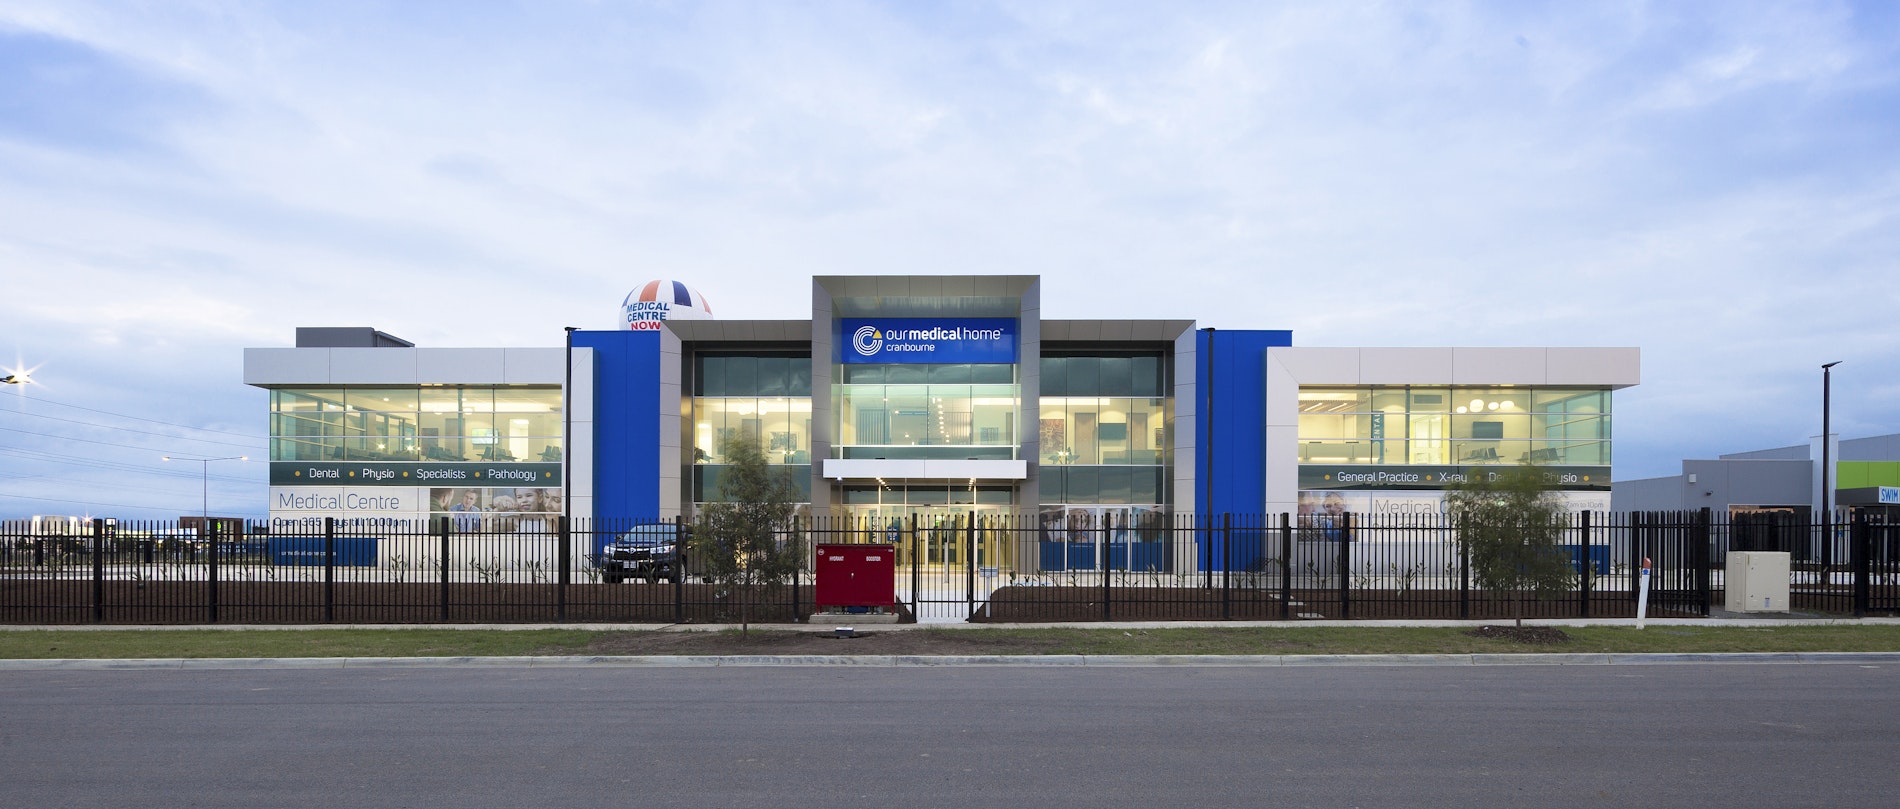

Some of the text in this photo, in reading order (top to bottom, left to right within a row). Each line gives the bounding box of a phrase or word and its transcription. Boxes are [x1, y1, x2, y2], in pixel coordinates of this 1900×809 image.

[627, 302, 670, 312] MEDICAL
[627, 311, 667, 322] CENTRE
[631, 321, 661, 331] NOW
[886, 343, 935, 352] cranbourne
[309, 468, 537, 482] Dental Physio Specialists Pathology
[1337, 471, 1377, 482] General
[1378, 471, 1419, 482] Practice
[1439, 472, 1468, 484] X-ray
[279, 493, 400, 510] Medical Centre
[1881, 488, 1899, 502] SWIM
[1375, 499, 1437, 515] Medical
[273, 516, 299, 529] Open
[301, 516, 322, 527] 365
[325, 516, 349, 529] ays
